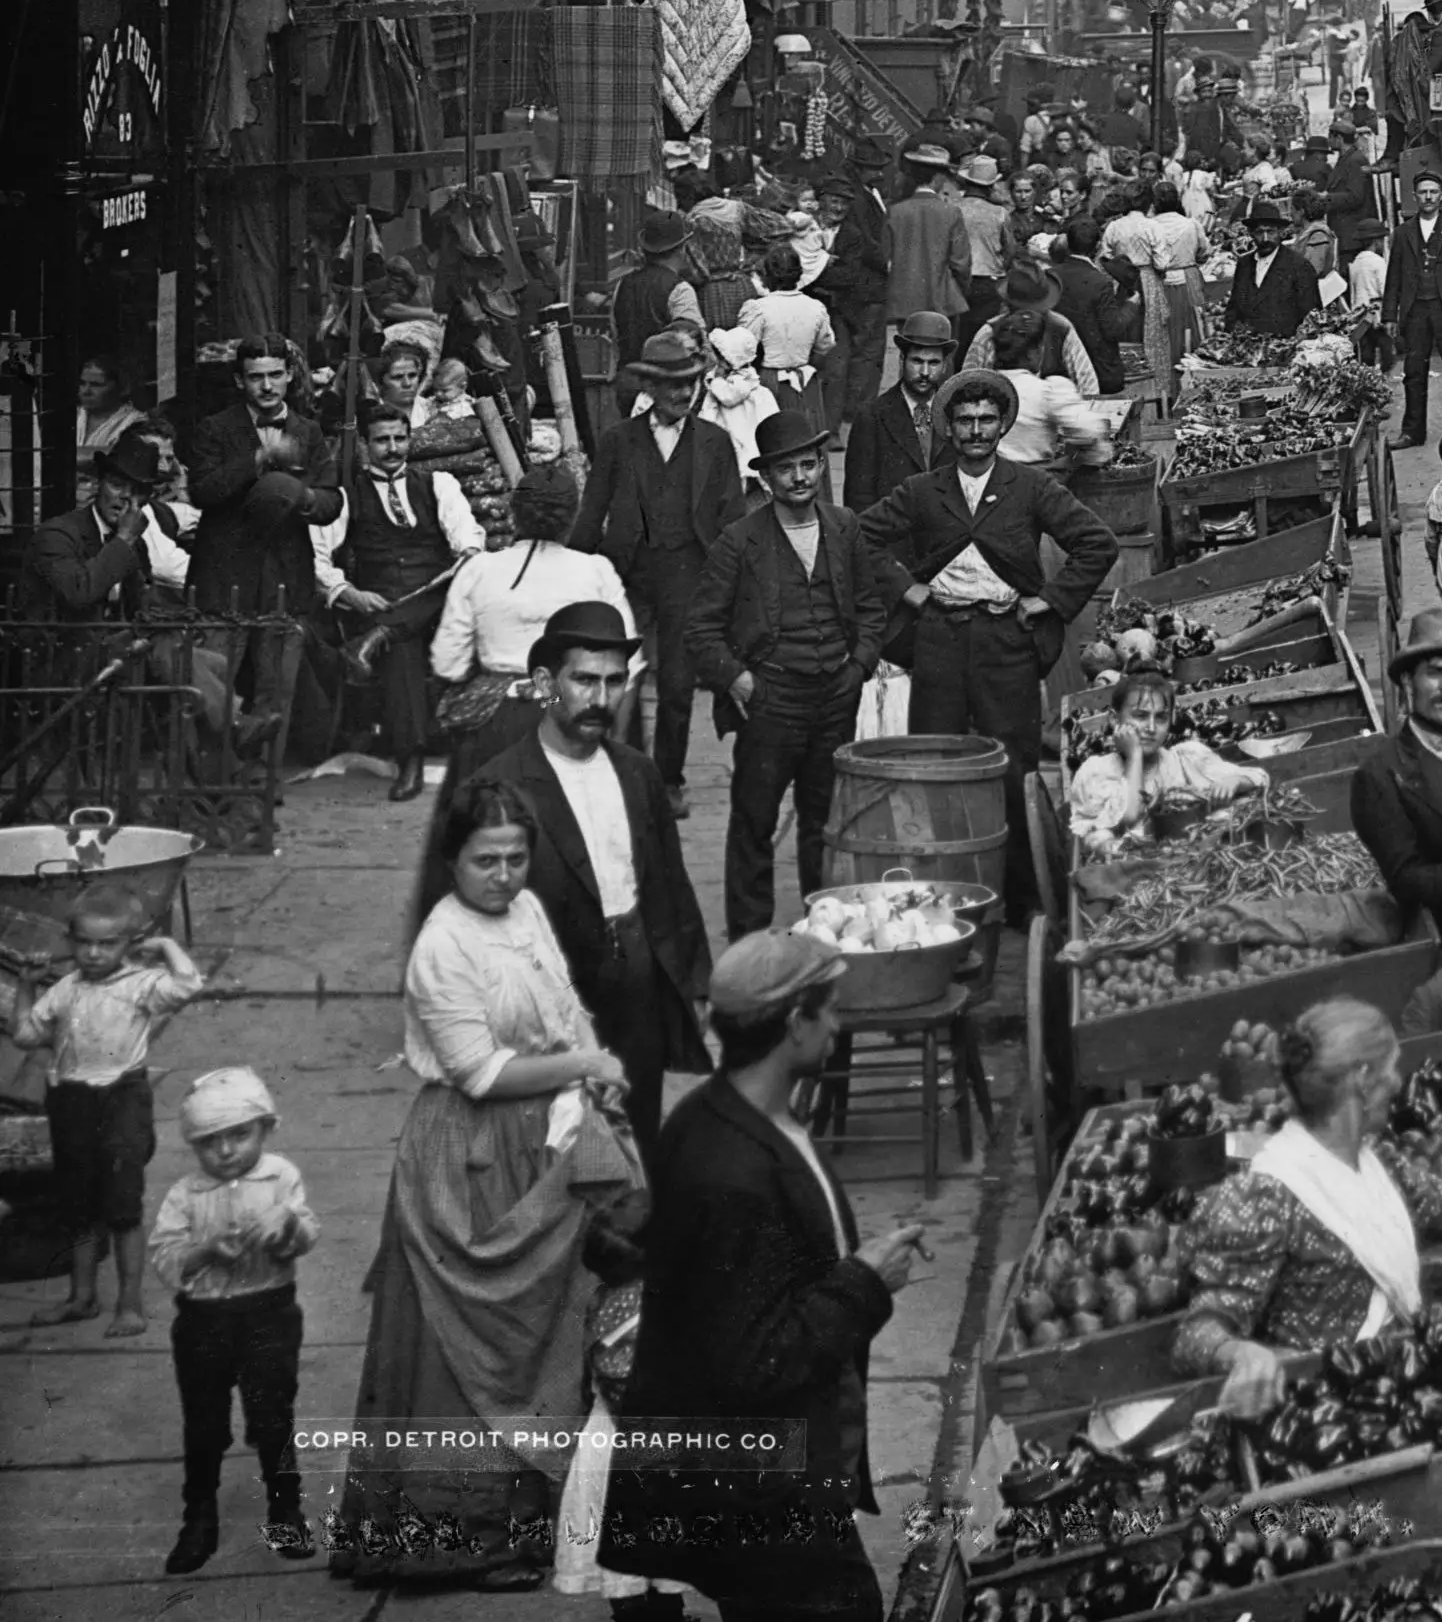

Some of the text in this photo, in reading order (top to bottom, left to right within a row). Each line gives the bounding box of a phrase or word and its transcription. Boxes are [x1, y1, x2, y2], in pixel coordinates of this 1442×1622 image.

[83, 43, 110, 143] RIZZO
[118, 112, 131, 142] 83
[103, 190, 147, 229] BROKERS
